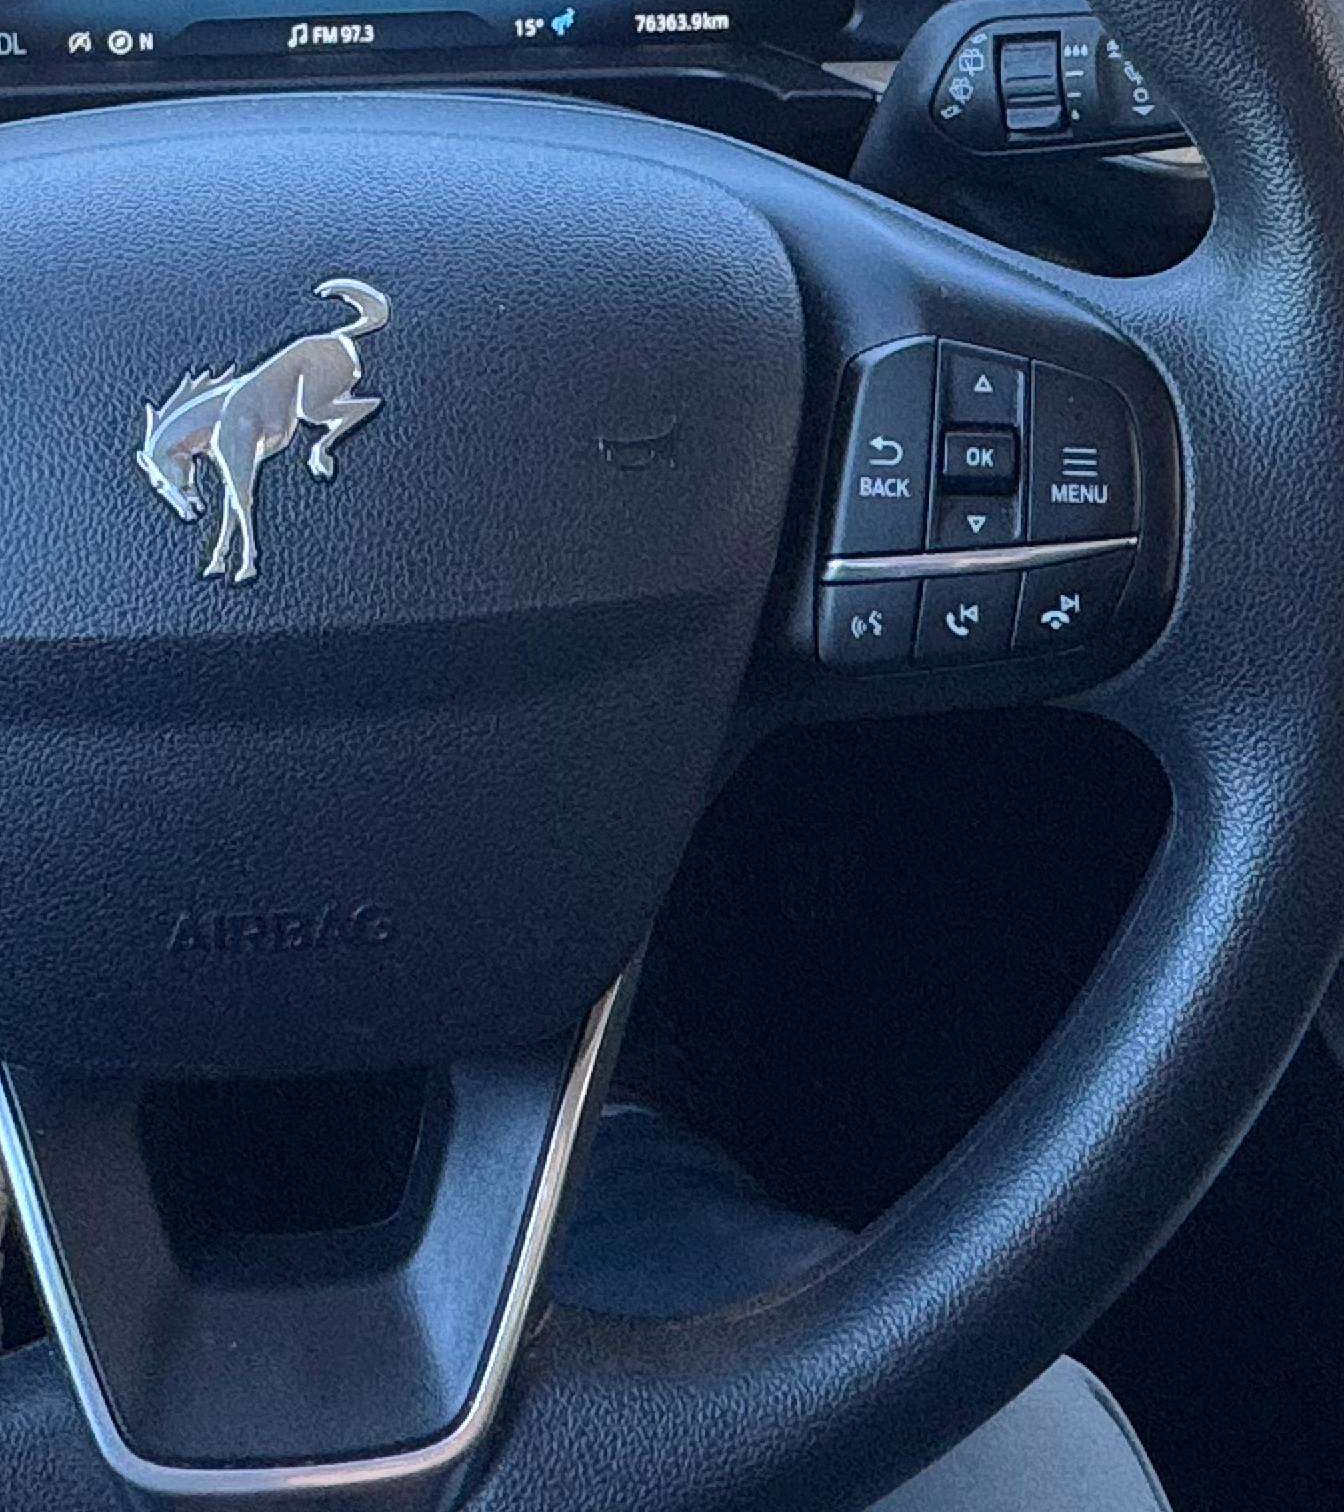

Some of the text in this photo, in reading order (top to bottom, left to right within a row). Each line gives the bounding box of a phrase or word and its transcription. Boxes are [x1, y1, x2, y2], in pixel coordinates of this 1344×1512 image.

[313, 24, 374, 43] FM 97.3
[966, 447, 994, 467] OK
[860, 477, 910, 498] BACK
[1051, 483, 1108, 504] MENU
[164, 898, 394, 952] AIRBAG
